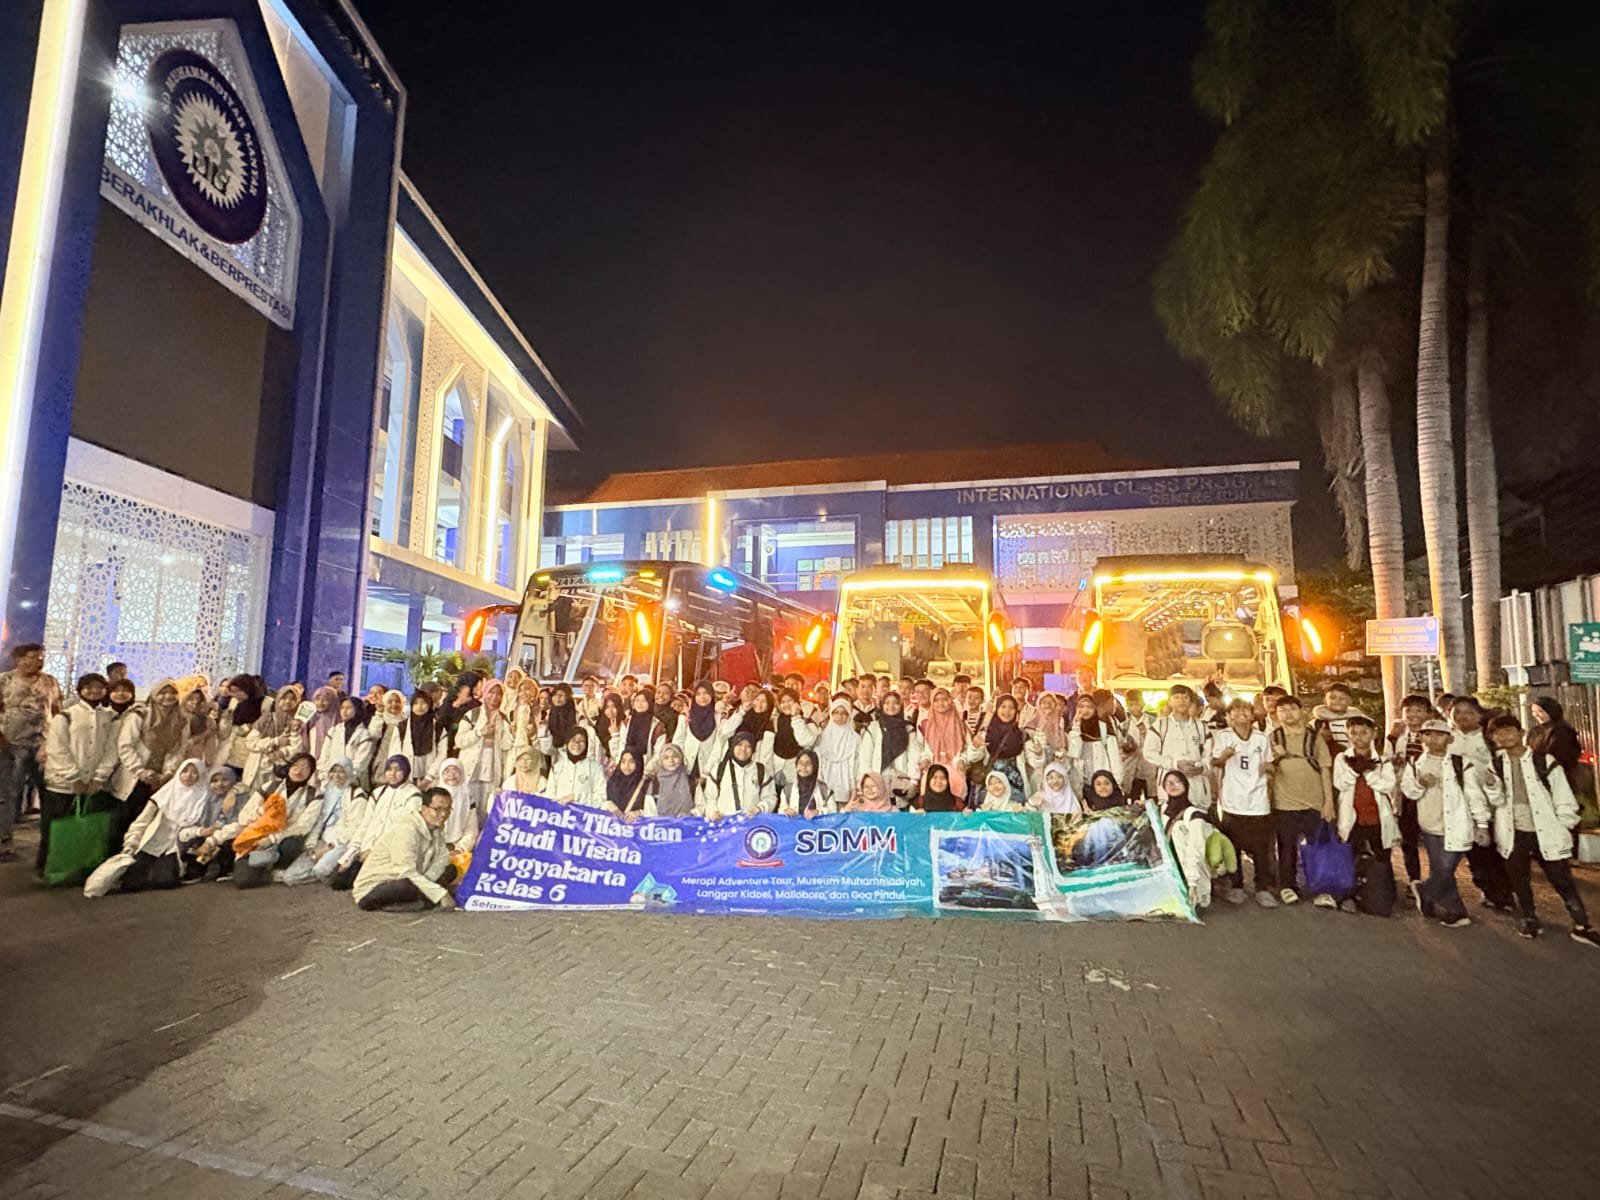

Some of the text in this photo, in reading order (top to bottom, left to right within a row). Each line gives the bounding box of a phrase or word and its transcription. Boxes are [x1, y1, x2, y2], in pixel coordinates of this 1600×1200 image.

[957, 482, 1109, 504] INTERNATIONAL
[1240, 756, 1249, 770] 6
[503, 797, 683, 843] Napak Tilas dan
[494, 823, 642, 865] Studi Wisata
[796, 828, 896, 855] SDMM
[488, 848, 627, 888] Yogyakarta
[474, 872, 568, 902] Kelas 6
[697, 889, 738, 901] Langgar
[740, 890, 773, 899] Kidoel,
[775, 890, 828, 900] Malioboro,
[829, 890, 849, 899] dan
[851, 890, 873, 899] Goa
[718, 878, 769, 886] Adventure
[771, 877, 795, 887] Tour,
[797, 877, 839, 886] Museum
[841, 876, 926, 888] Muhammadiyah,
